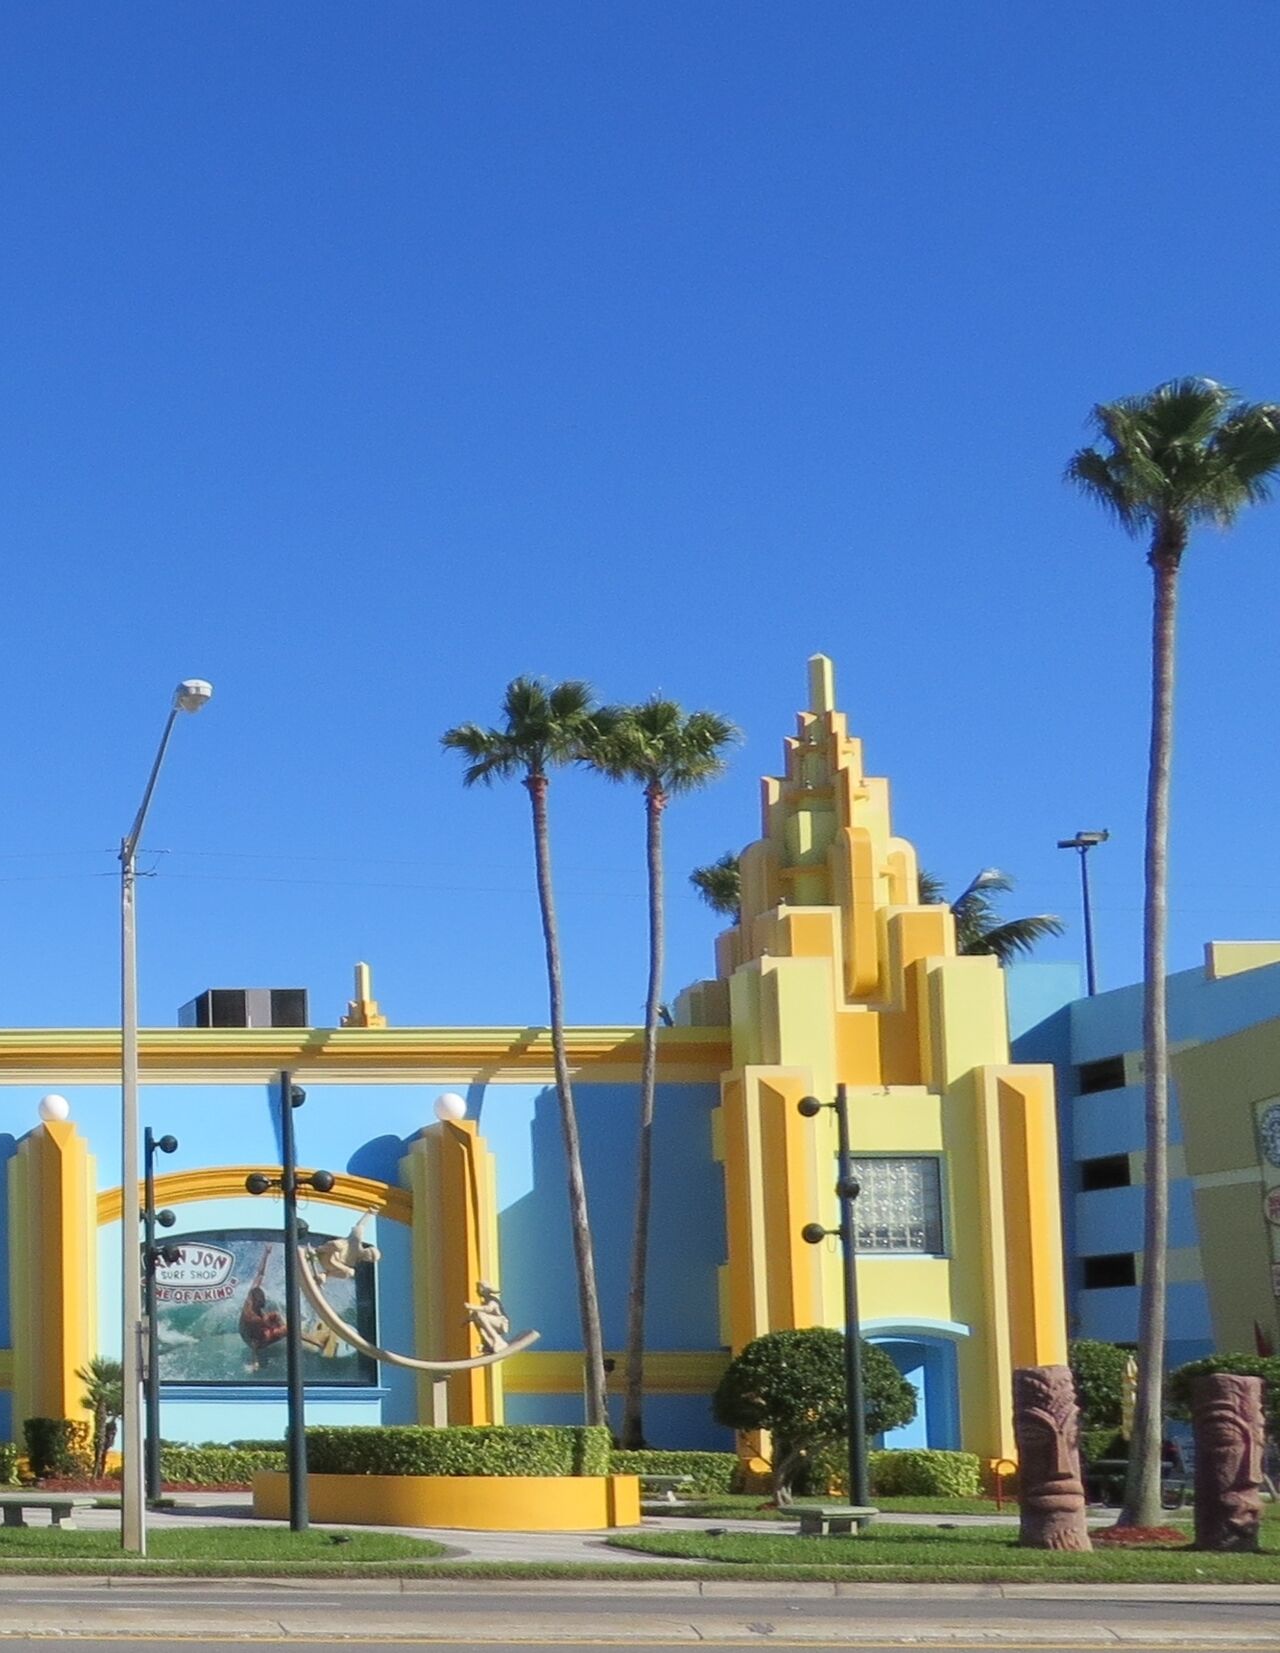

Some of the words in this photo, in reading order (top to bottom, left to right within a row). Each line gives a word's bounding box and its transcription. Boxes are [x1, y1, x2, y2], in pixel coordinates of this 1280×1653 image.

[191, 1251, 228, 1270] JON
[160, 1270, 185, 1280] SURF
[190, 1270, 217, 1280] SHOP
[175, 1290, 191, 1301] OF
[194, 1290, 202, 1301] A
